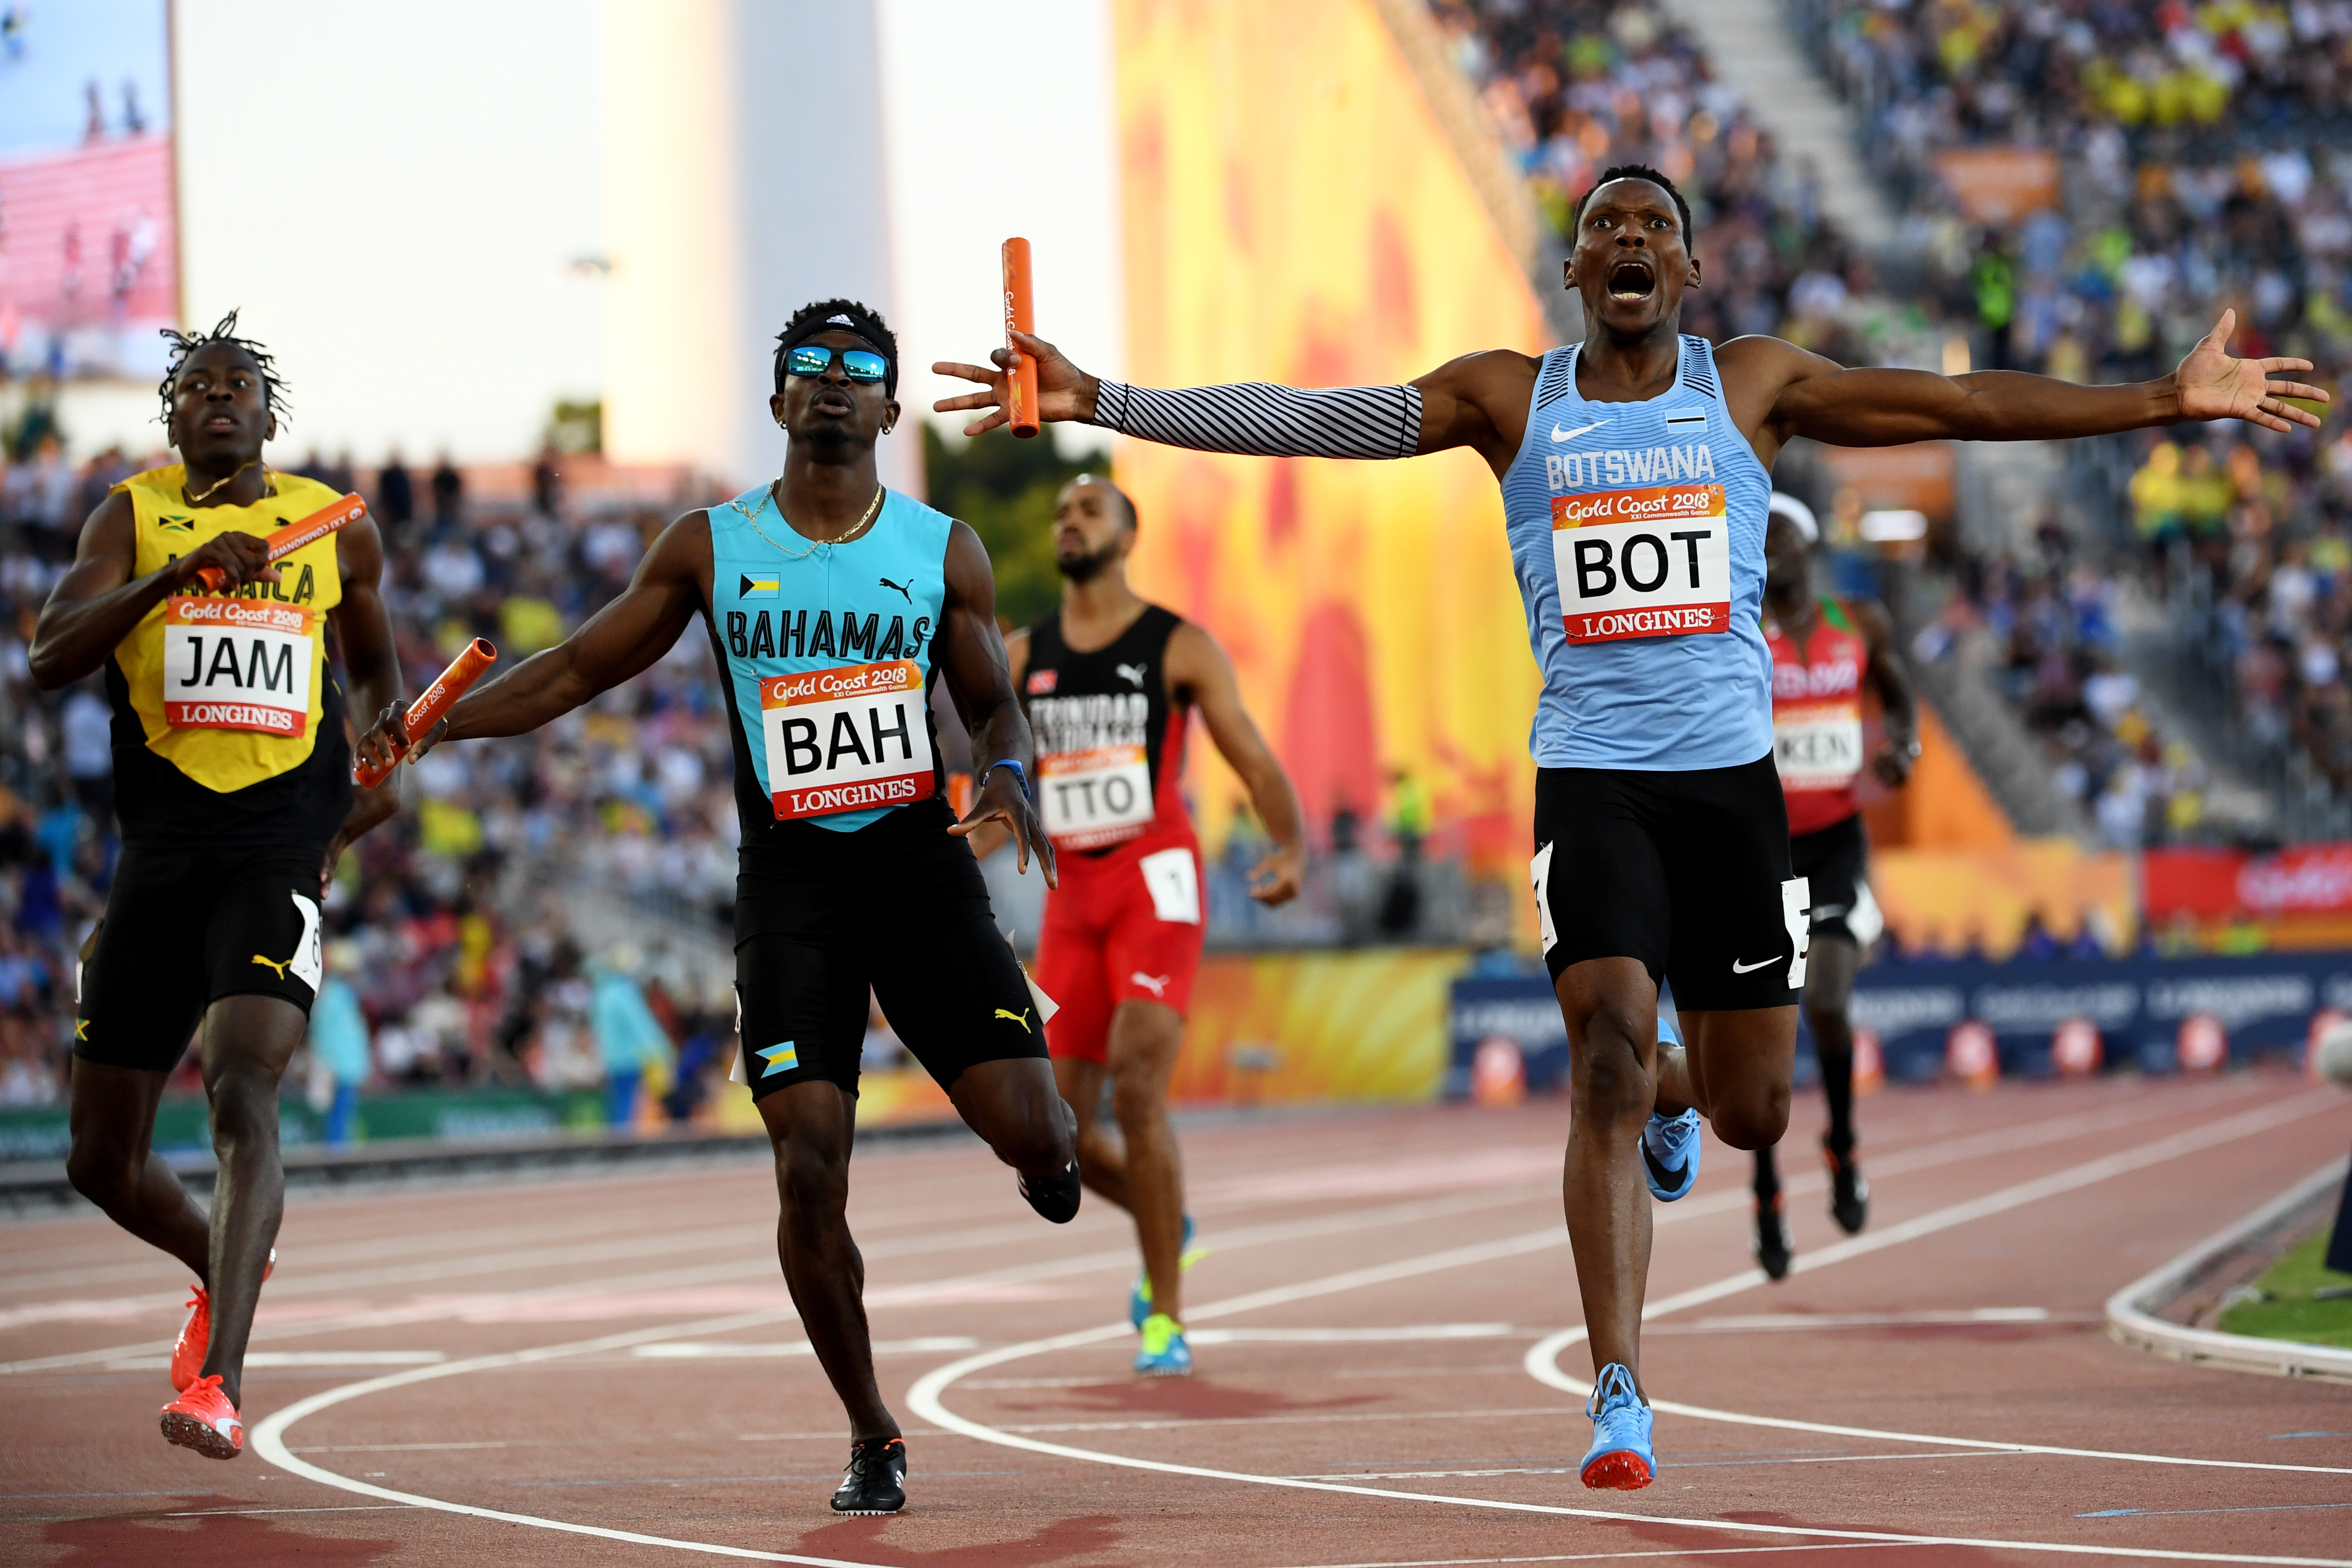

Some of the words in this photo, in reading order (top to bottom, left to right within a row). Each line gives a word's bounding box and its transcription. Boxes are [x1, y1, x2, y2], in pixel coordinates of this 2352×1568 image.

[1005, 291, 1015, 320] Gold
[1546, 444, 1715, 490] BOTSWANA
[330, 515, 347, 530] XXI
[1565, 497, 1613, 521] Gold
[1617, 494, 1670, 514] Coast
[1672, 492, 1710, 510] 2018
[1643, 510, 1689, 520] Commonwealth
[1574, 530, 1711, 599] BOT
[179, 602, 224, 620] Gold
[225, 603, 270, 622] Coast
[272, 609, 303, 628] 2018
[1583, 608, 1712, 637] LONGINES
[727, 610, 930, 660] BAHAMAS
[181, 636, 293, 694] JAM
[774, 677, 816, 701] Gold
[820, 671, 869, 693] Coast
[871, 667, 907, 686] 2018
[844, 684, 888, 697] Commonwealth
[182, 705, 292, 730] LONGINES
[408, 700, 430, 726] Coast
[428, 683, 446, 705] 2018
[782, 704, 912, 776] BAH
[791, 778, 916, 813] LONGINES
[1055, 775, 1135, 819] TTO
